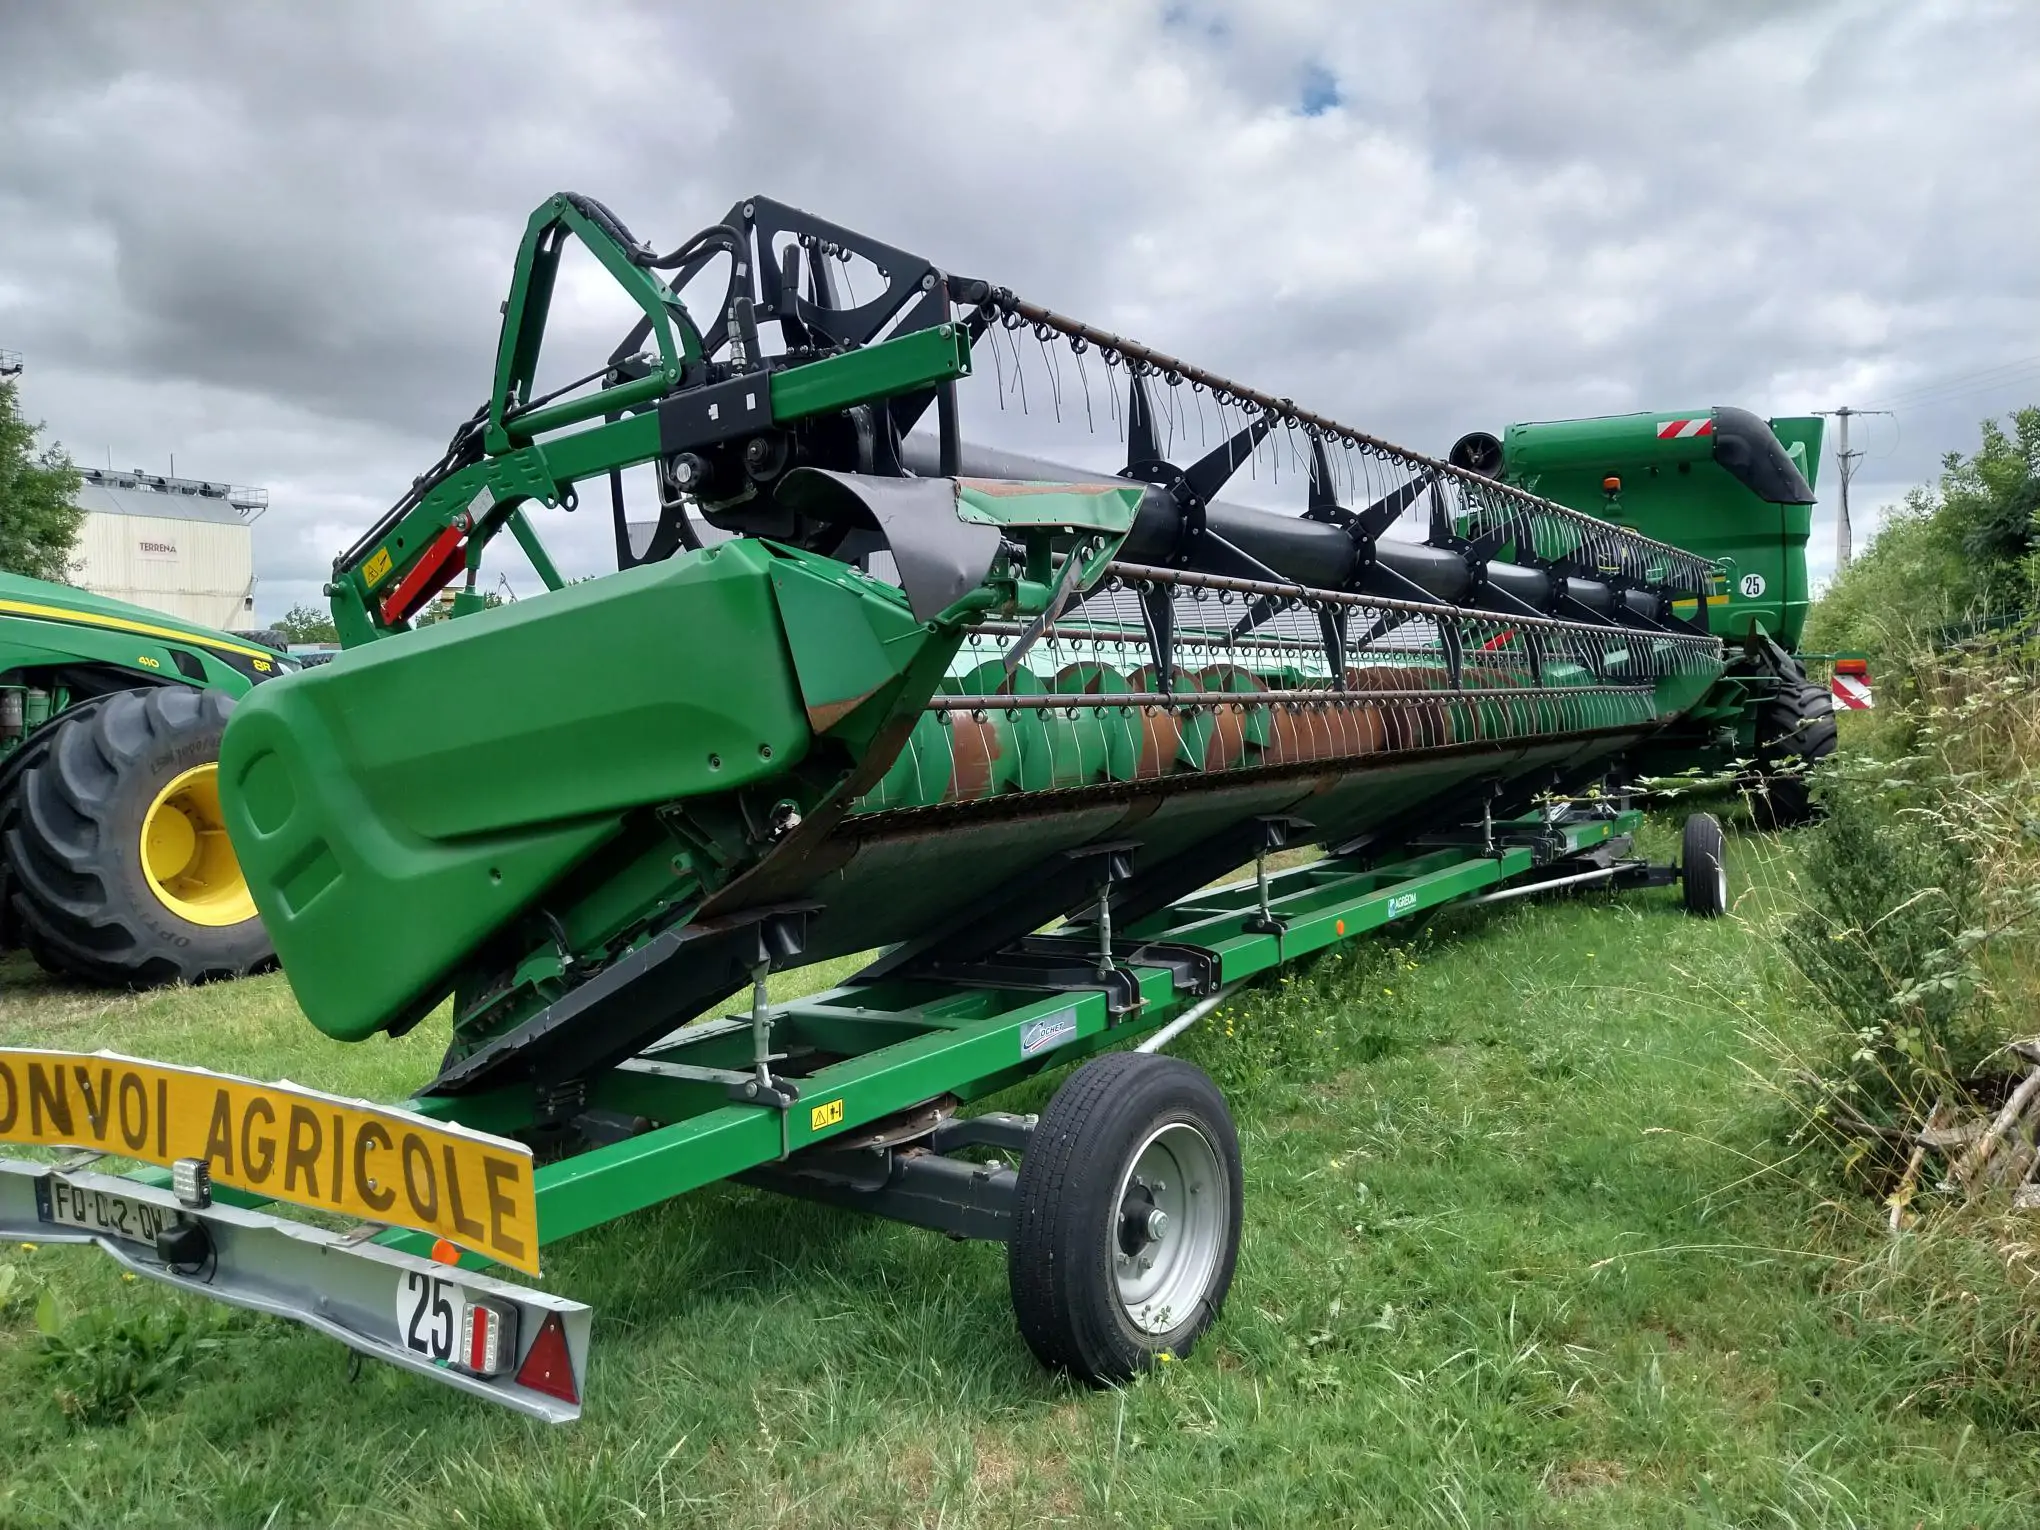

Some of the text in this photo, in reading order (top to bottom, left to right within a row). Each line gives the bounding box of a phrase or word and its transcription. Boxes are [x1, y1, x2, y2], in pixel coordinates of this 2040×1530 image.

[139, 541, 177, 554] TERRENA
[1746, 577, 1760, 595] 25
[138, 656, 160, 668] 410
[253, 659, 272, 672] 8R
[203, 1089, 525, 1261] AGRICOLE
[408, 1271, 454, 1361] 25
